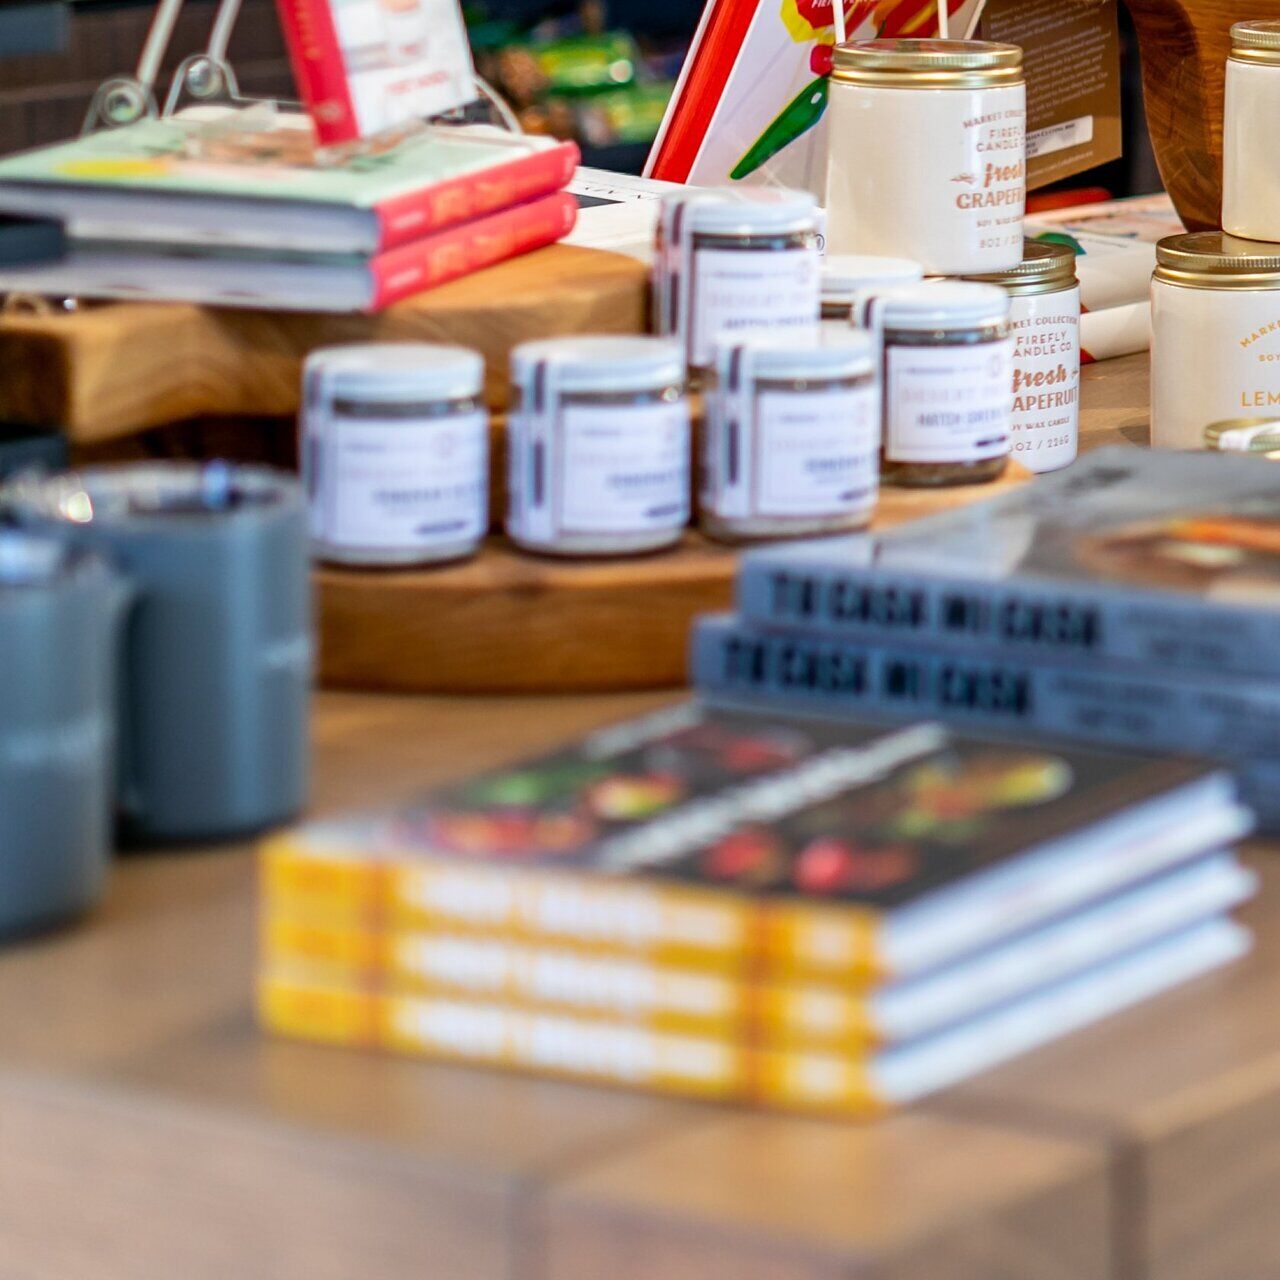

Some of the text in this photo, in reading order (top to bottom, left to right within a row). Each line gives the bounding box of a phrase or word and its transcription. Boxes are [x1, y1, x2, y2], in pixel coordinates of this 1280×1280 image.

[1016, 331, 1067, 346] FIREFLY
[1012, 344, 1056, 358] ANDLE
[1258, 353, 1280, 362] SOY
[1011, 363, 1067, 393] fresh
[1011, 387, 1078, 412] APEFRUIT
[1025, 420, 1045, 430] WAX
